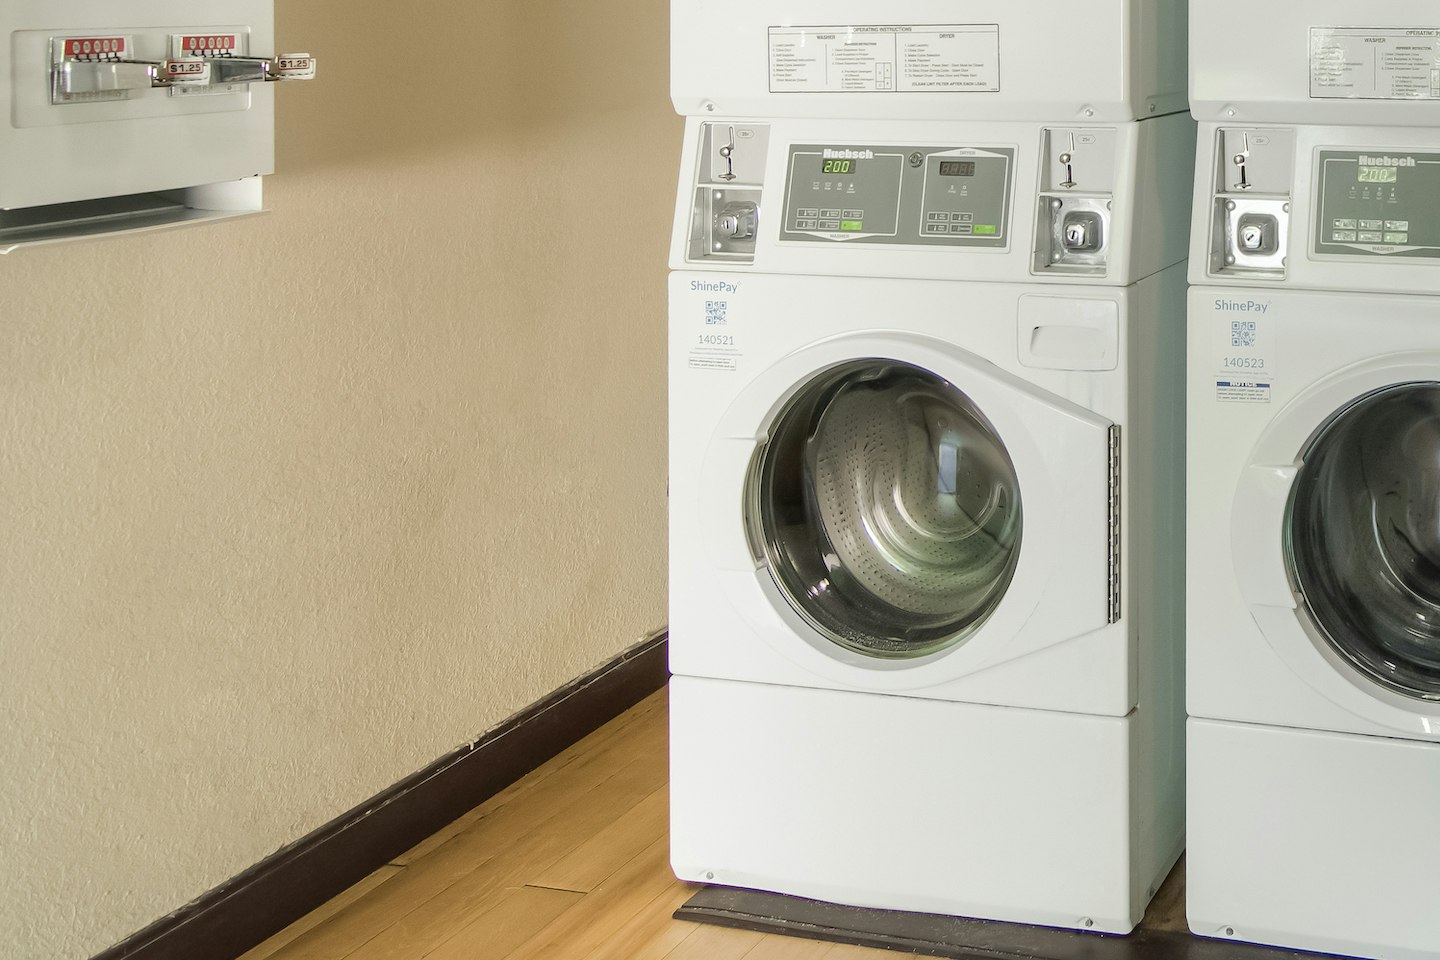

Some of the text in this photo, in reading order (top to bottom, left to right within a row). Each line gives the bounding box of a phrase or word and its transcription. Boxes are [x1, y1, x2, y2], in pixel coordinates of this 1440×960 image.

[170, 63, 201, 73] $1.25
[280, 60, 307, 68] $1.25
[823, 148, 874, 159] Huebsch
[824, 160, 850, 173] 200
[1358, 155, 1416, 167] Huebsch
[1359, 168, 1388, 181] 200
[690, 280, 738, 294] ShinePay
[1215, 299, 1268, 313] ShinePay
[698, 334, 735, 345] 140521
[1223, 357, 1265, 368] 140523
